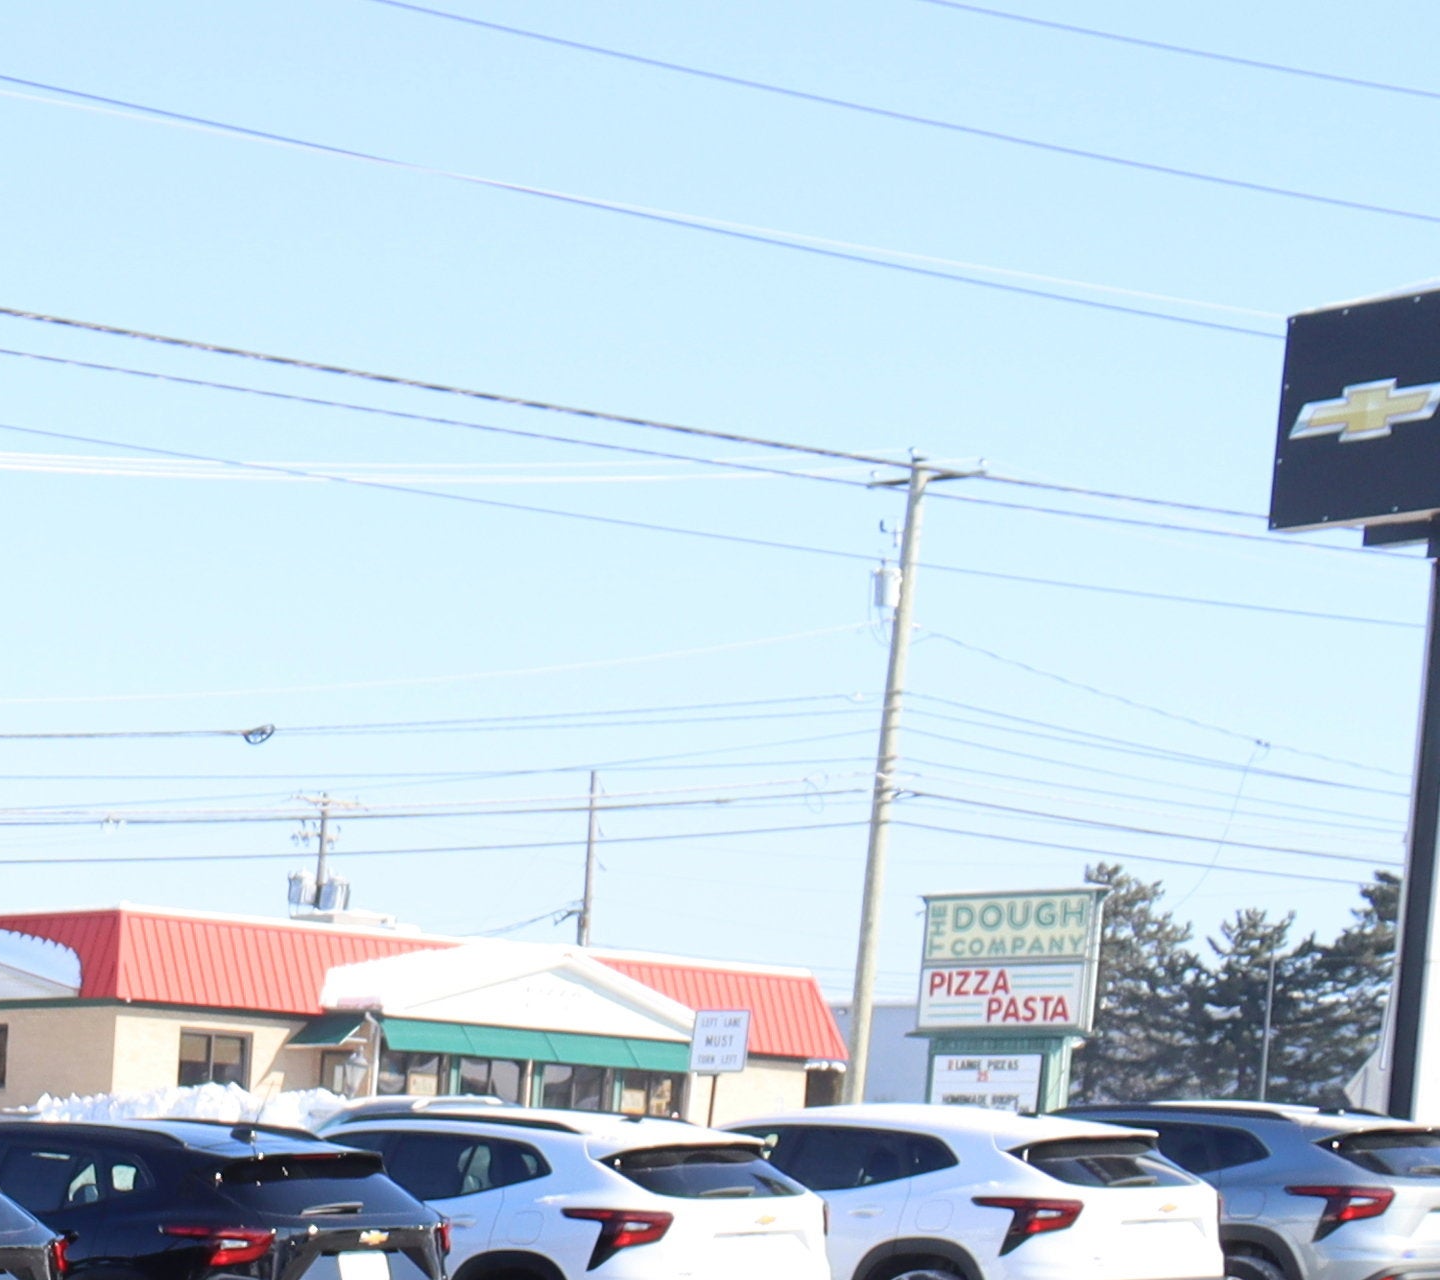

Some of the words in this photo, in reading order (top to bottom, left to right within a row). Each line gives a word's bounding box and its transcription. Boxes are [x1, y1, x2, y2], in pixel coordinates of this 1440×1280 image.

[929, 903, 947, 954] THE
[952, 899, 1085, 932] DOUGH
[951, 935, 1084, 956] COMPANY
[929, 970, 1009, 996] PIZZA
[986, 996, 1069, 1022] PASTA
[705, 1034, 734, 1048] MUST
